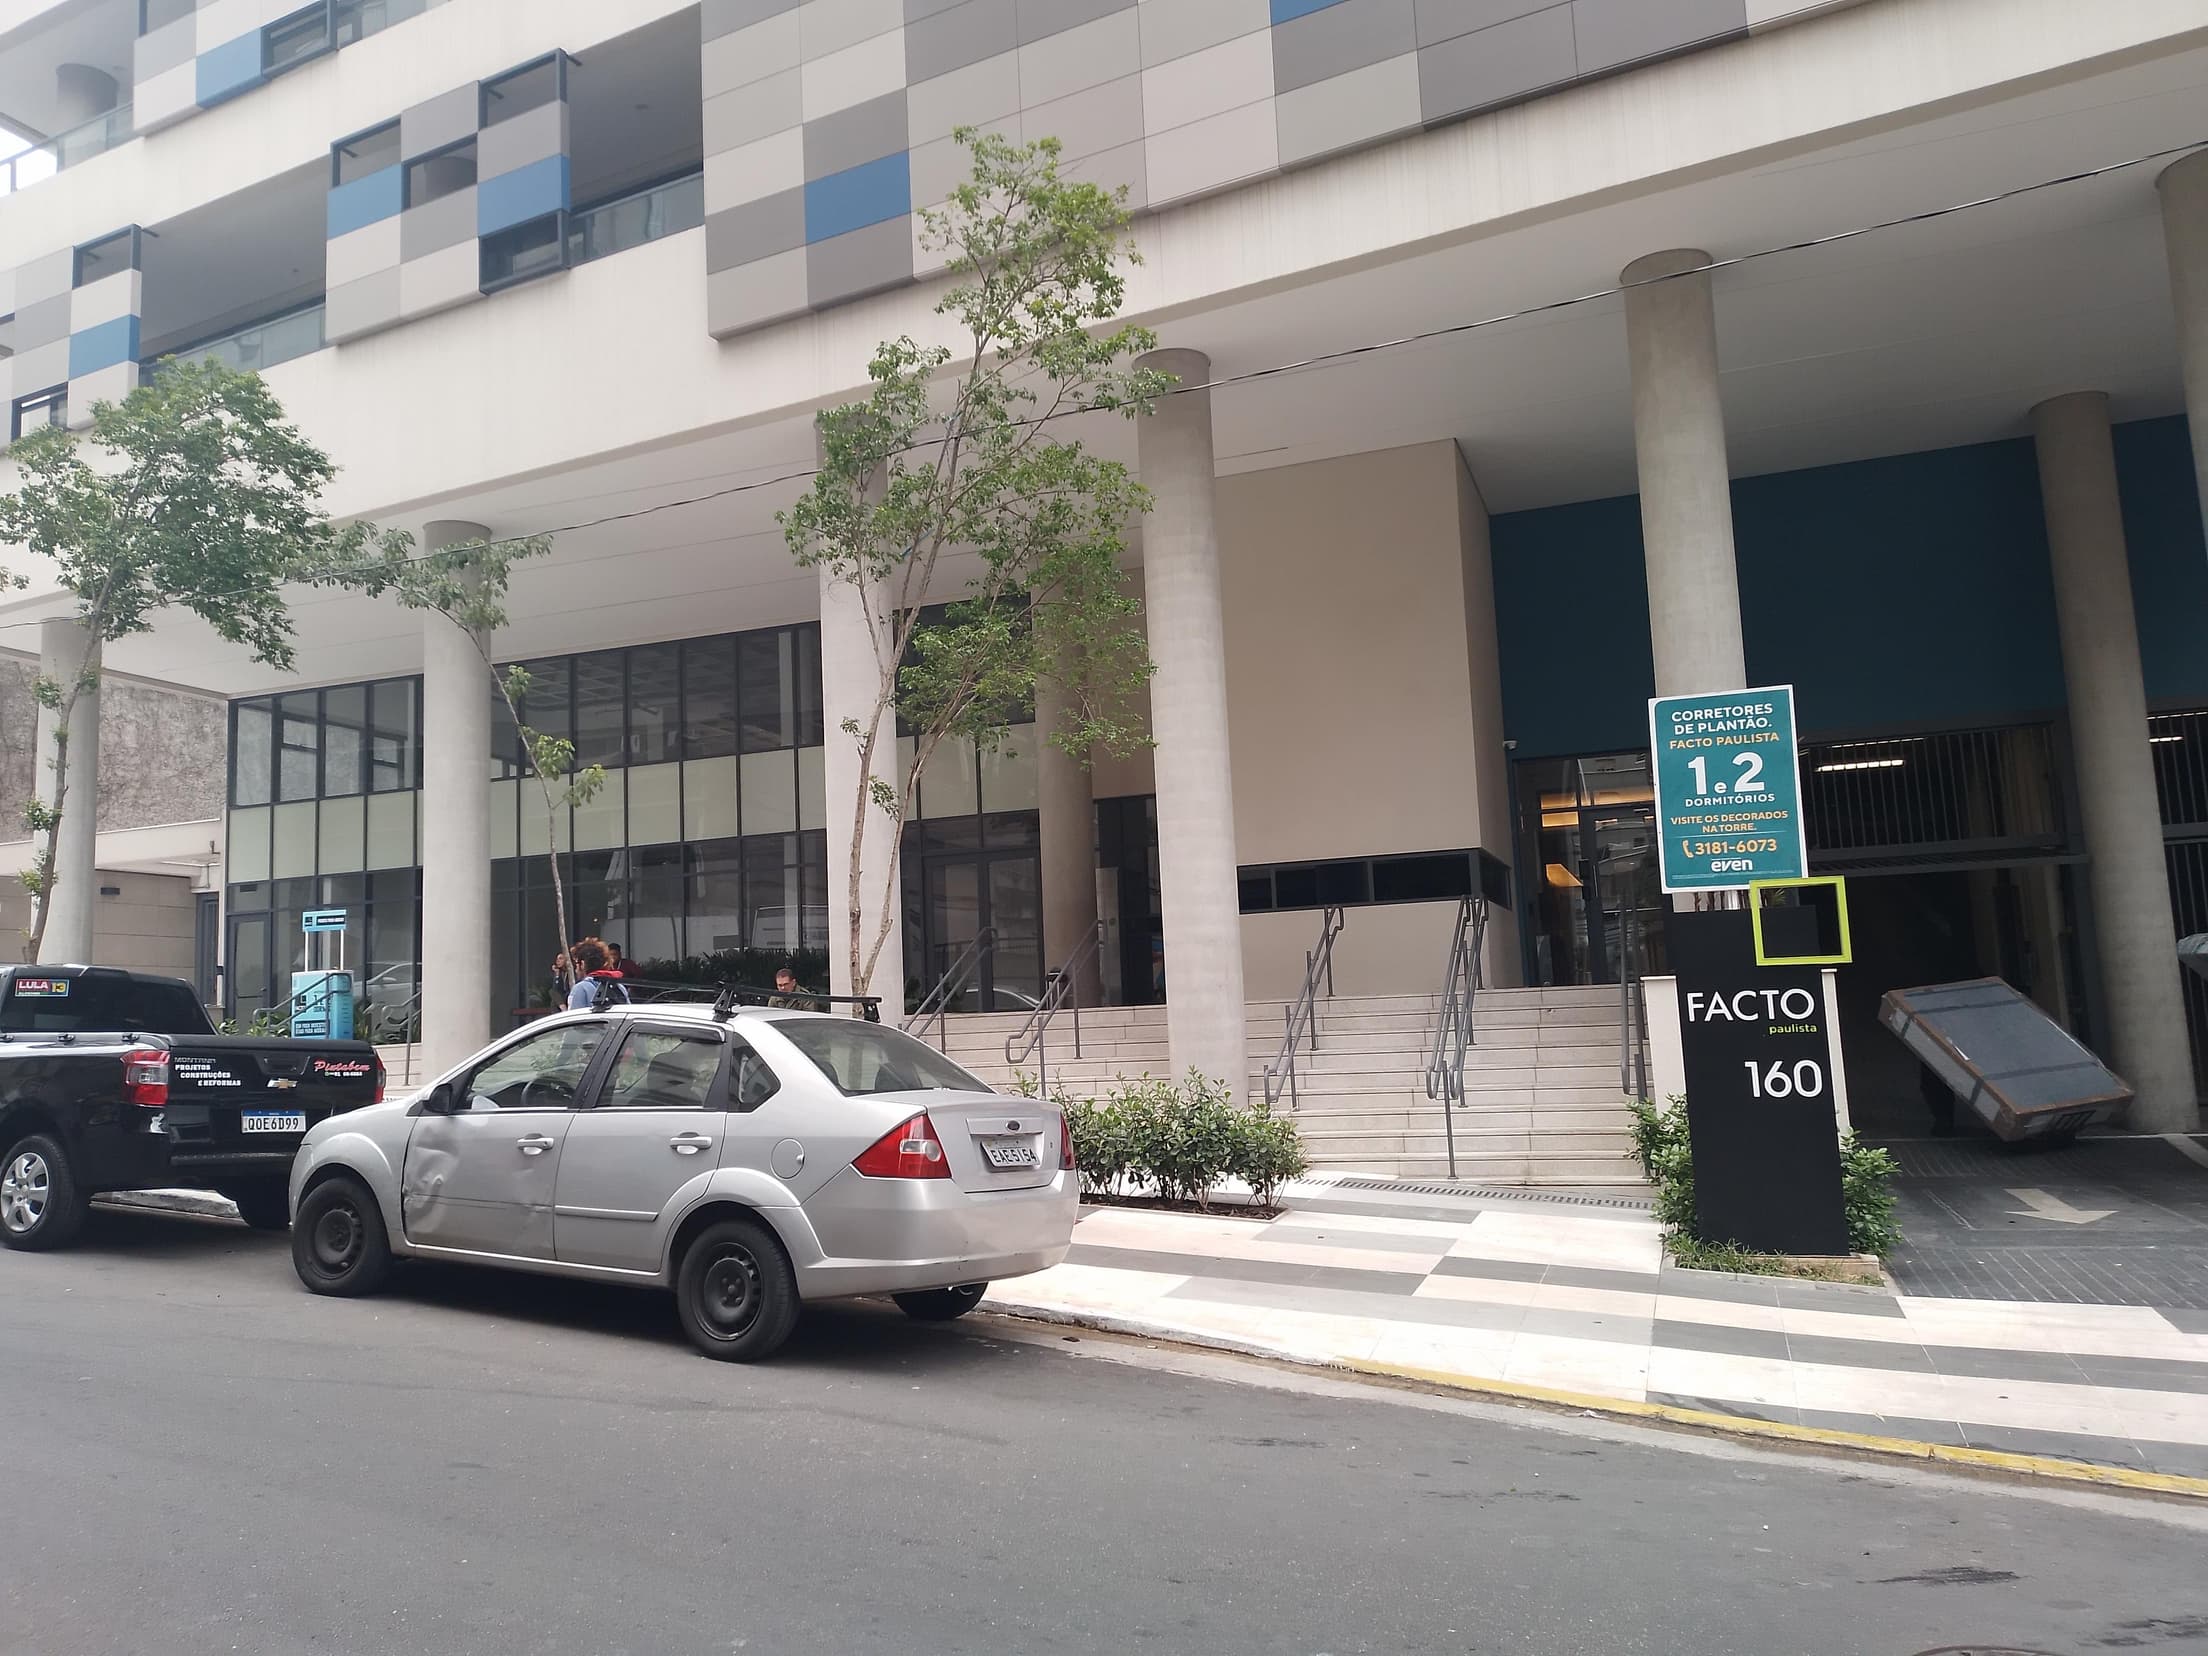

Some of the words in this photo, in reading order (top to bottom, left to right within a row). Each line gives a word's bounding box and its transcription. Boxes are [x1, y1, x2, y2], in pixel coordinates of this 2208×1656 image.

[1671, 703, 1773, 722] CORRETORES
[1674, 723, 1694, 735] DE
[1698, 716, 1772, 733] PLANTÃO.
[1669, 737, 1713, 750] FACTO
[1716, 732, 1780, 746] PAULISTA
[1687, 756, 1707, 795] 1
[1714, 781, 1727, 794] e
[1732, 752, 1765, 793] 2
[1685, 793, 1775, 807] DORMITÓRIOS
[1671, 815, 1703, 825] VISITE
[1704, 814, 1719, 823] OS
[1721, 810, 1789, 822] DECORADOS
[1702, 824, 1718, 833] NA
[1719, 822, 1757, 832] TORRE.
[1695, 838, 1777, 855] 3181-6073
[1711, 859, 1753, 872] even
[18, 981, 48, 989] LULA
[1686, 988, 1815, 1022] FACTO
[1768, 1024, 1817, 1035] paulista
[1744, 1059, 1823, 1098] 160
